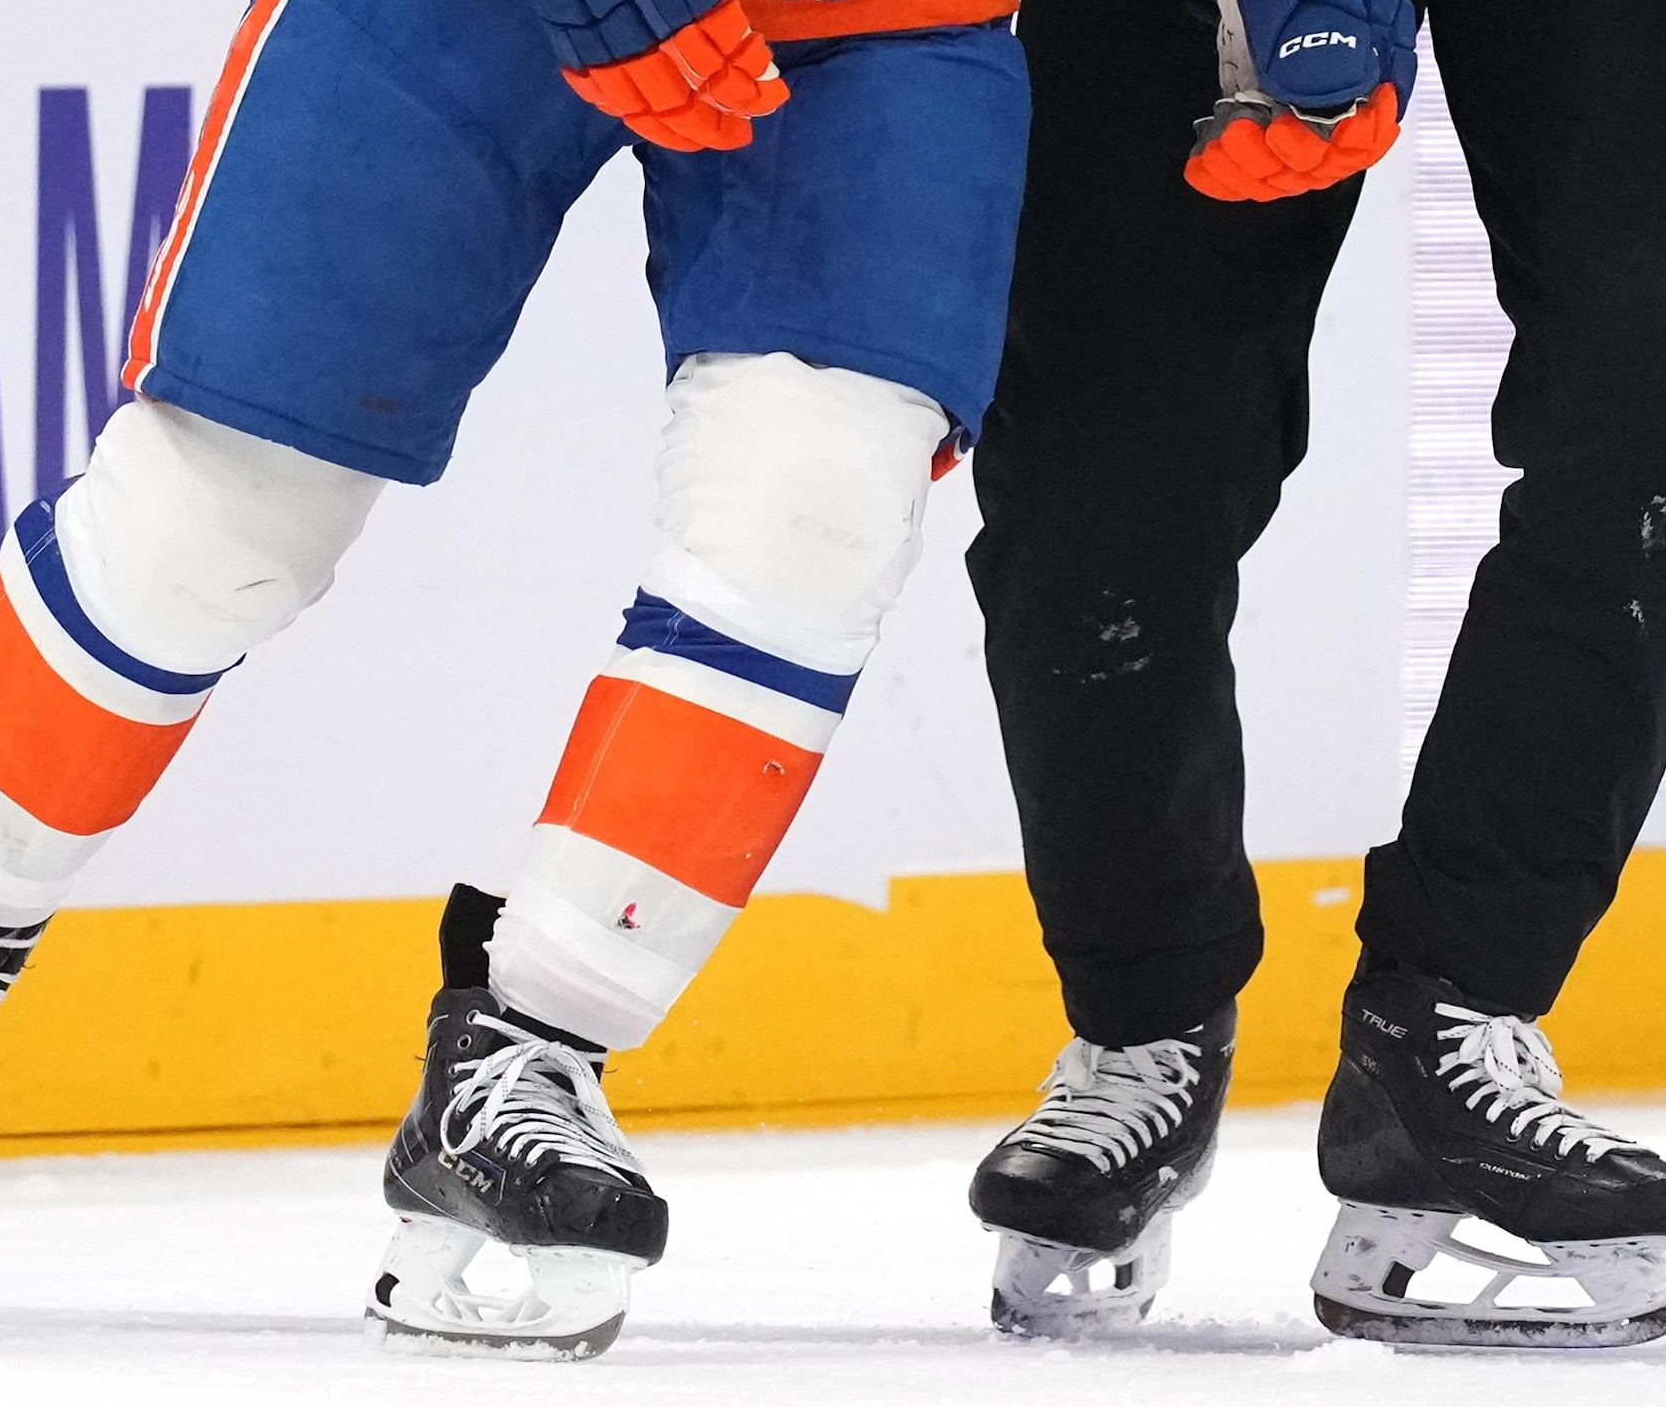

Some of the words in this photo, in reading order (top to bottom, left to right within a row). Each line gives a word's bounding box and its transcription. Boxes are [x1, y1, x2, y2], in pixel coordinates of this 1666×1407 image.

[1278, 31, 1357, 59] CCM
[1361, 1008, 1409, 1040] TRUE
[437, 1148, 495, 1194] CCM
